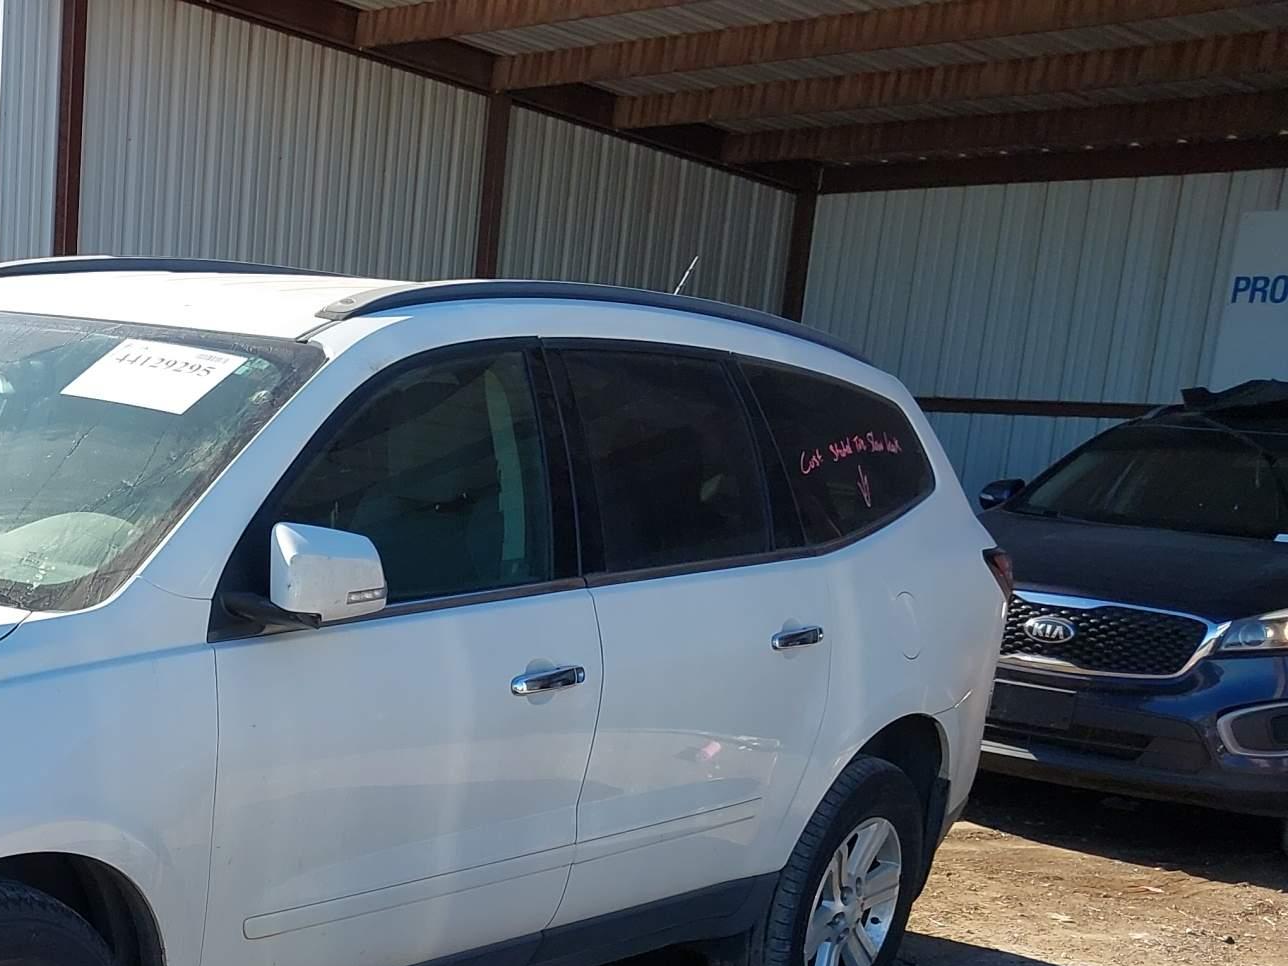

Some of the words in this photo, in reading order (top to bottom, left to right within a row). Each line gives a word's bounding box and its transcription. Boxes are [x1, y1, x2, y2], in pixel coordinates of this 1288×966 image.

[1231, 274, 1288, 304] PRO
[115, 352, 216, 378] 44129295
[1032, 622, 1065, 640] KIA
